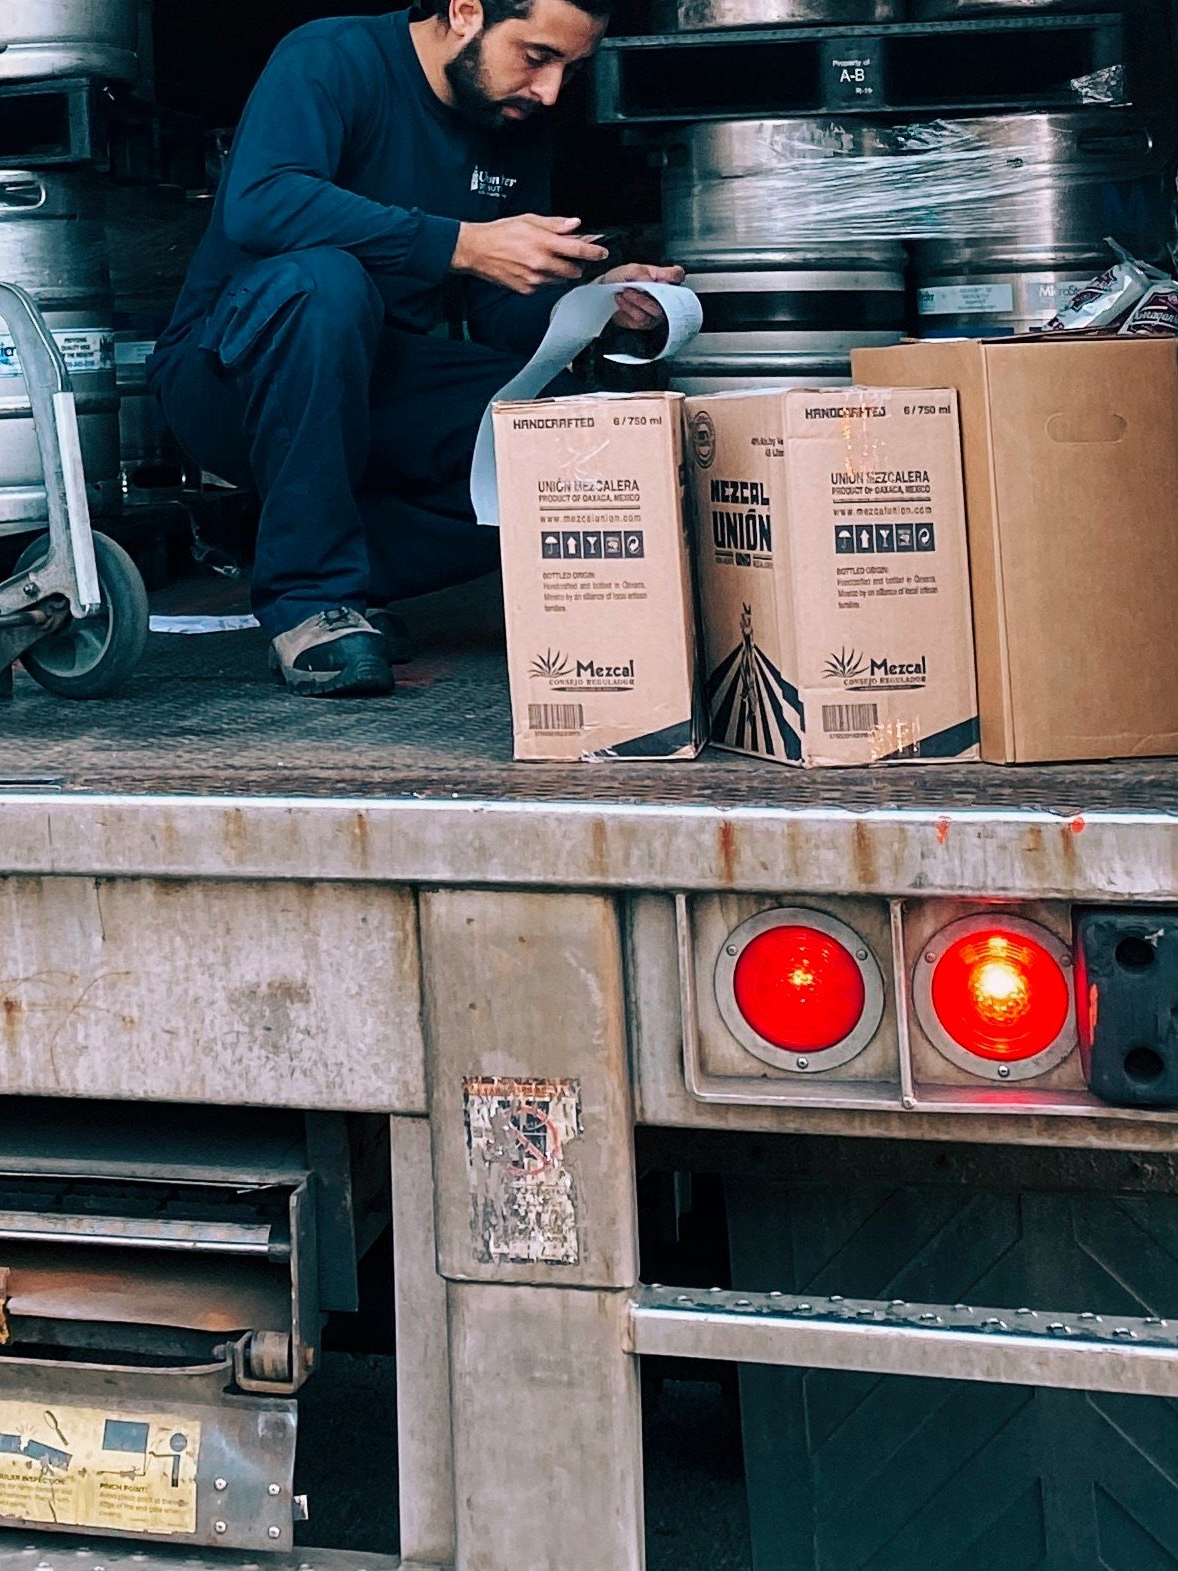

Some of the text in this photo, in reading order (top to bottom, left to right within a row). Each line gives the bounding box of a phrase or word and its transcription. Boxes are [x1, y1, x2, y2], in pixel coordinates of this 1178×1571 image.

[840, 68, 865, 83] A-B
[805, 406, 886, 419] HANDCRAFTED
[513, 417, 595, 430] HANDCRAFTED
[538, 494, 570, 503] PRODUCT
[613, 493, 641, 502] MEXICO
[710, 479, 770, 506] MEZCAL
[711, 508, 773, 553] UNIÓN
[576, 659, 635, 678] Mezcal
[870, 655, 927, 676] Mezcal
